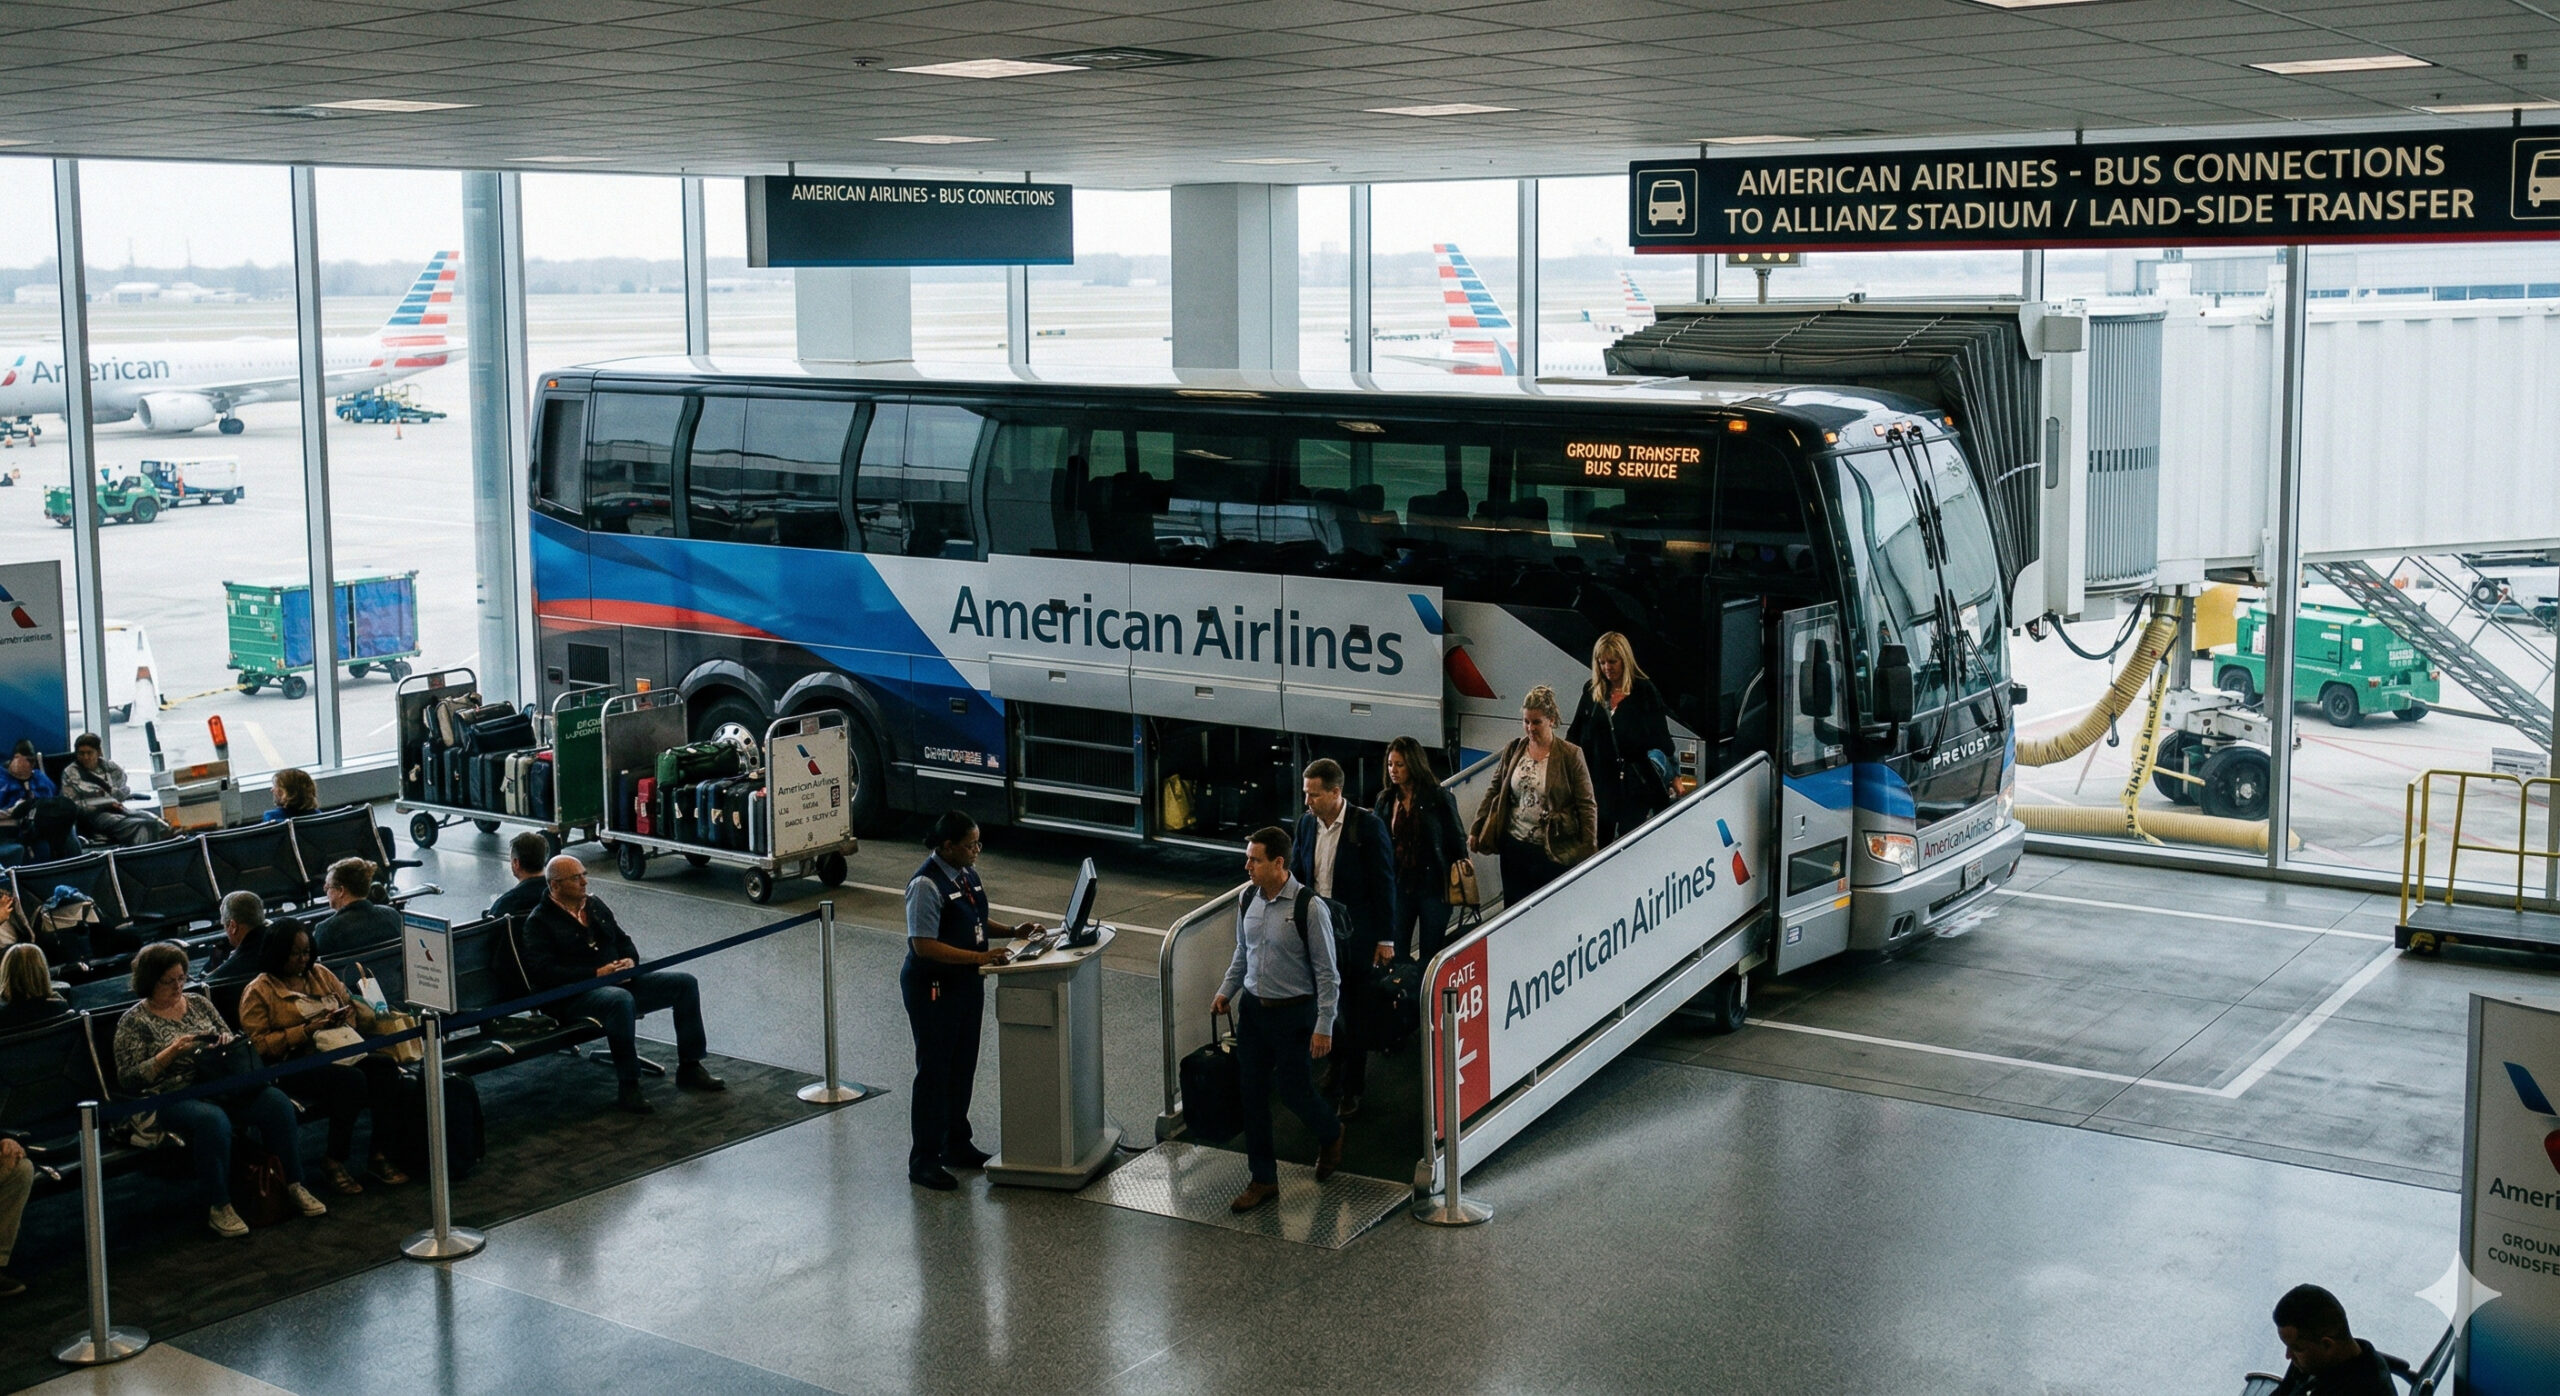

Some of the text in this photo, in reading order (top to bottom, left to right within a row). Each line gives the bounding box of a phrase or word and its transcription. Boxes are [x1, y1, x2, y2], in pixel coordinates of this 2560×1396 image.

[1737, 165, 1900, 196] AMERICAN
[1911, 159, 2058, 191] AIRLINES
[2094, 155, 2161, 186] BUS
[2173, 144, 2445, 184] CONNECTIONS
[791, 184, 866, 202] AMERICAN
[869, 186, 928, 203] AIRLINES
[940, 187, 964, 204] BUS
[968, 188, 1055, 206] CONNECTIONS
[1724, 188, 2474, 234] TO ALLIANZ STADIUM / LAND-SIDE TRANSFER
[1567, 443, 1700, 463] GROUND TRANSFER
[1585, 461, 1678, 479] BUS SERVICE
[949, 585, 1404, 676] American Airlines
[1932, 735, 1991, 770] PREVOST
[1923, 832, 1964, 860] American
[1505, 857, 1716, 1031] American Airlines
[1448, 961, 1476, 988] GATE
[2489, 1177, 2560, 1211] Ameri
